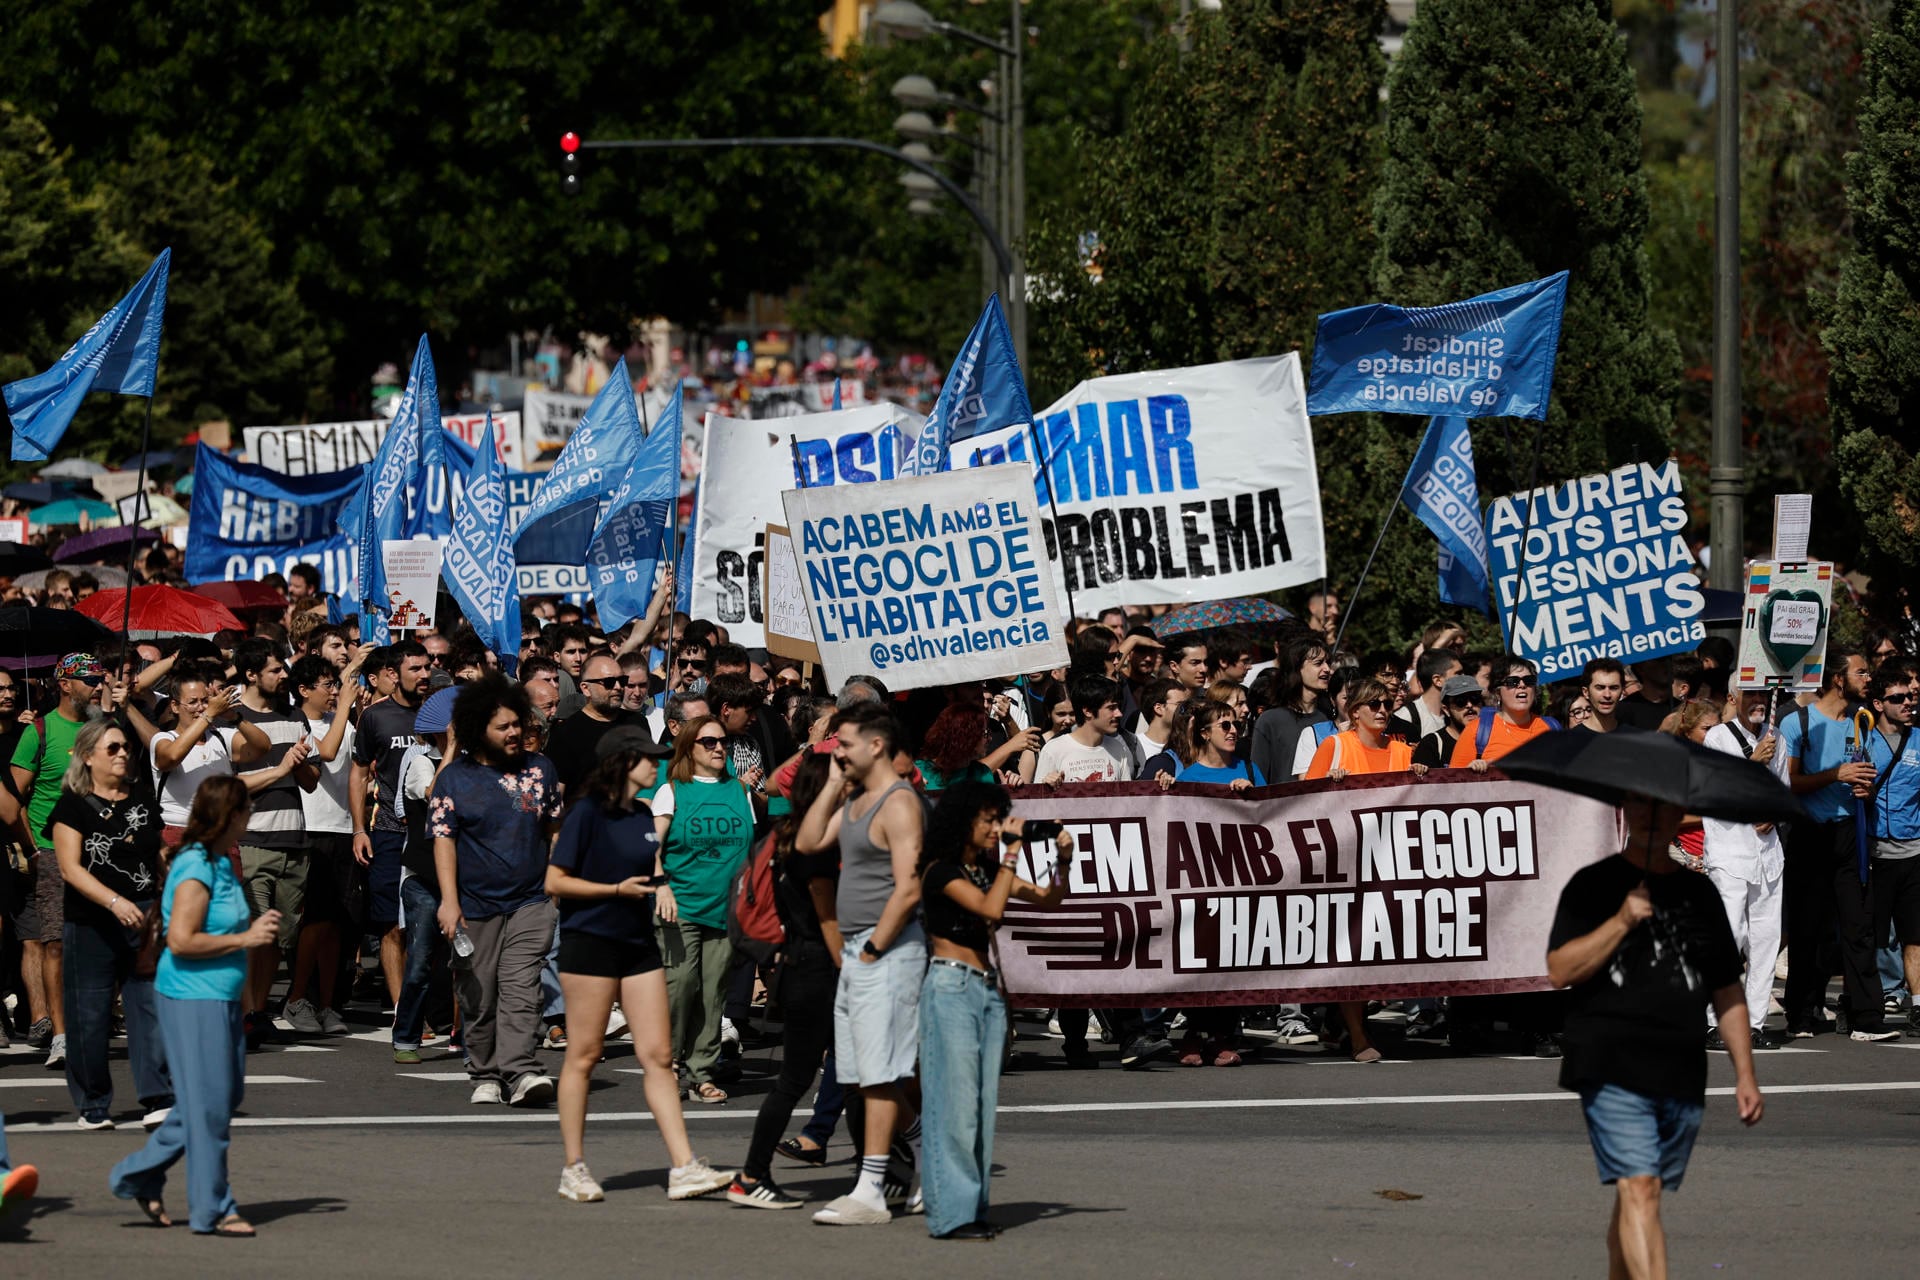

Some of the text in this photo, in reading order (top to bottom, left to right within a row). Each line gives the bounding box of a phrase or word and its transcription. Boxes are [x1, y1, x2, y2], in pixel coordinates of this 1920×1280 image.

[219, 488, 346, 542] HABIT
[1417, 476, 1447, 506] DE
[1491, 458, 1683, 536] ATUREM
[803, 501, 1028, 555] ACABEM AMB EL
[1493, 515, 1605, 570] TOTS
[1611, 496, 1688, 544] ELS
[519, 570, 549, 589] DE
[806, 527, 1036, 601] NEGOCI DE
[1499, 534, 1696, 608] DESNONA
[816, 574, 1045, 642] L'HABITATGE
[1506, 572, 1706, 656] MENTS
[1786, 618, 1802, 628] 50%
[870, 618, 1050, 669] @sdhvalencia
[690, 817, 742, 835] STOP
[1166, 821, 1284, 889] AMB
[1288, 818, 1349, 884] EL
[1359, 805, 1535, 882] NEGOCI
[1180, 887, 1482, 969] L'HABITATGE
